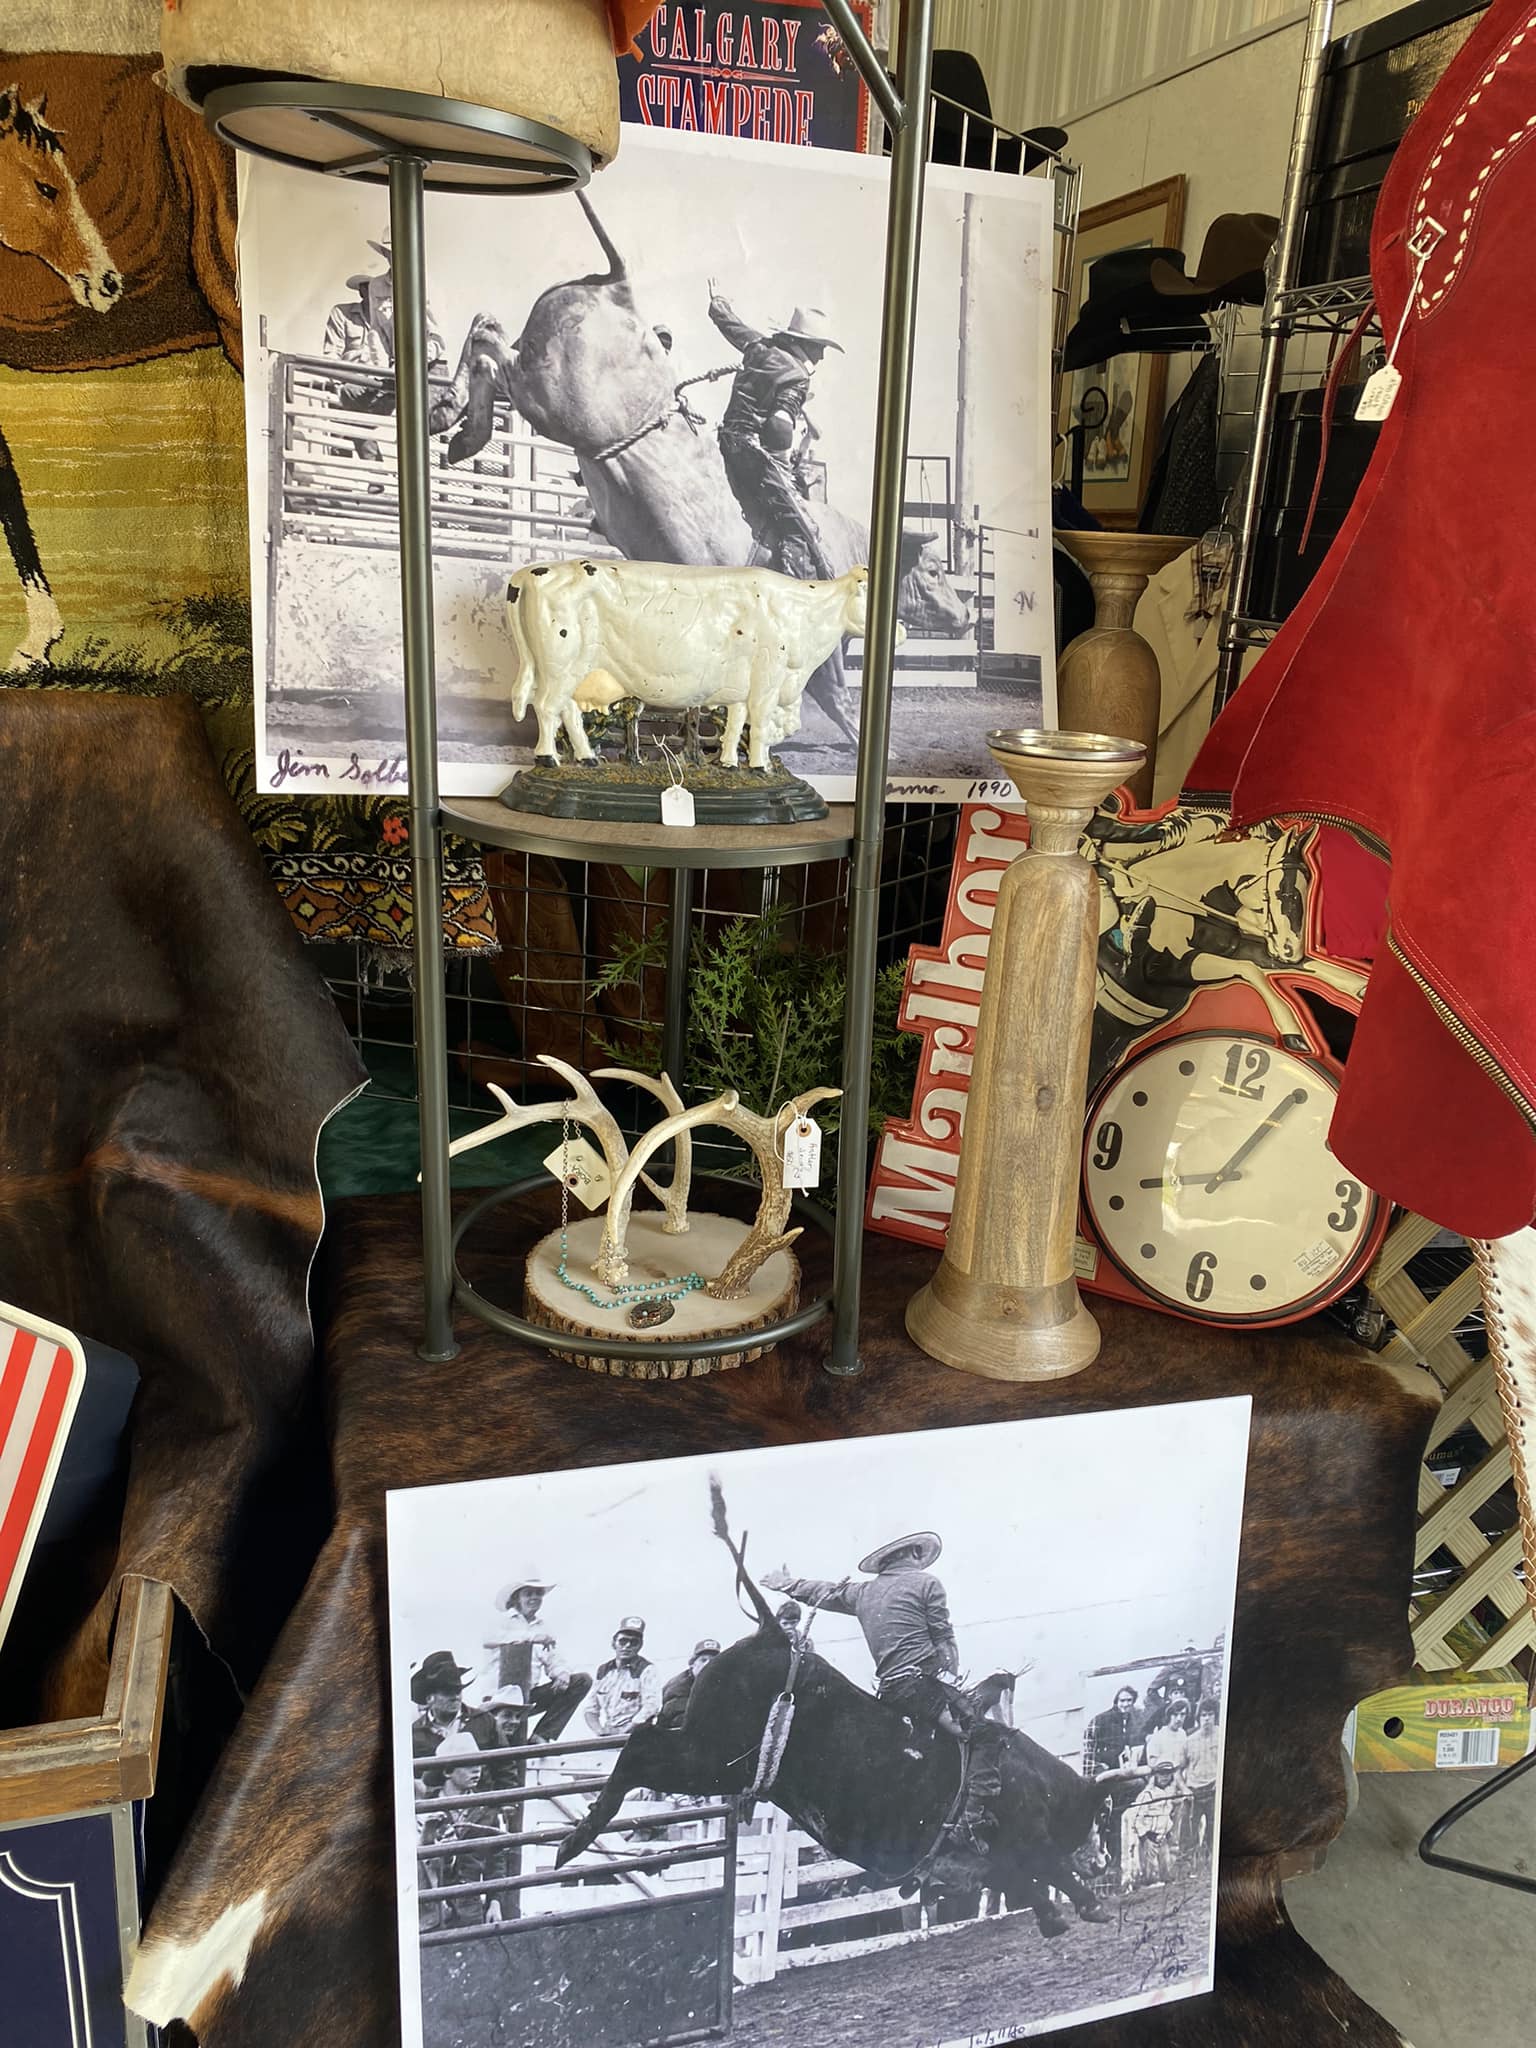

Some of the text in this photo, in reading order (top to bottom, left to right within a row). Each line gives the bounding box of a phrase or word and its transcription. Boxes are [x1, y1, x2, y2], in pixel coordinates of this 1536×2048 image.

[650, 4, 801, 73] CALGARY
[637, 73, 814, 147] STAMPEDE
[269, 748, 330, 788] Jim
[967, 780, 1012, 799] 1990
[871, 803, 1028, 1232] Marlbor
[1218, 1043, 1272, 1102] 12
[1093, 1121, 1123, 1170] 9
[1327, 1180, 1362, 1232] 3
[1185, 1251, 1218, 1302] 6
[1424, 1697, 1514, 1718] DURANGO
